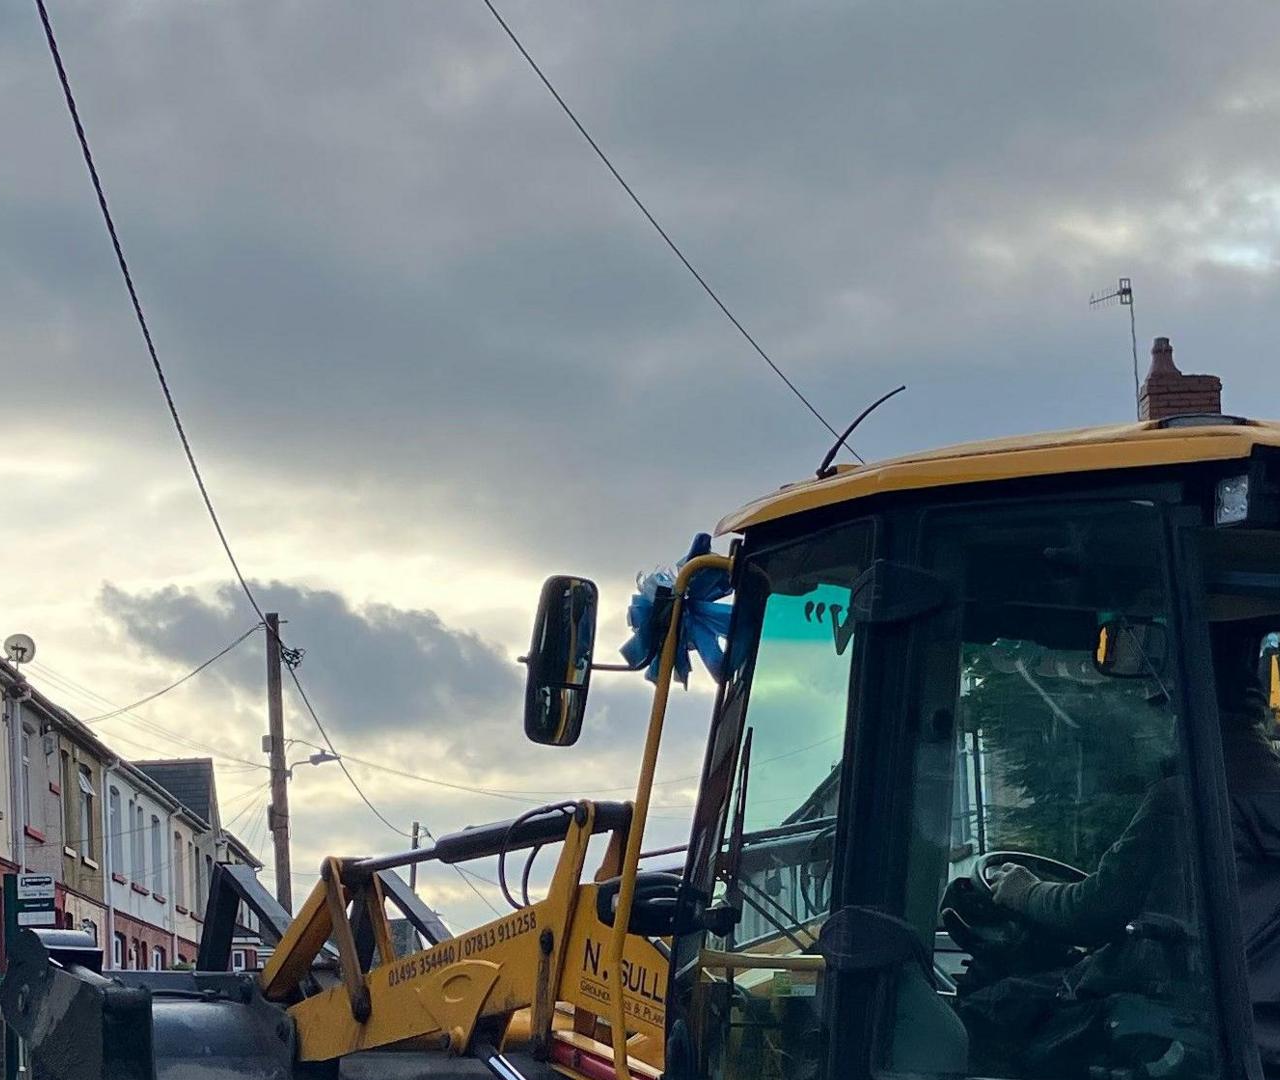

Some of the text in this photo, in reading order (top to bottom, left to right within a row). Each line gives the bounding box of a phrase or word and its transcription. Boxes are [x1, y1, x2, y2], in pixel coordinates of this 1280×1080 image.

[388, 960, 417, 987] 01495
[419, 945, 455, 976] 354440
[464, 926, 496, 957] 07813
[497, 911, 537, 943] 911258
[583, 938, 609, 981] N.
